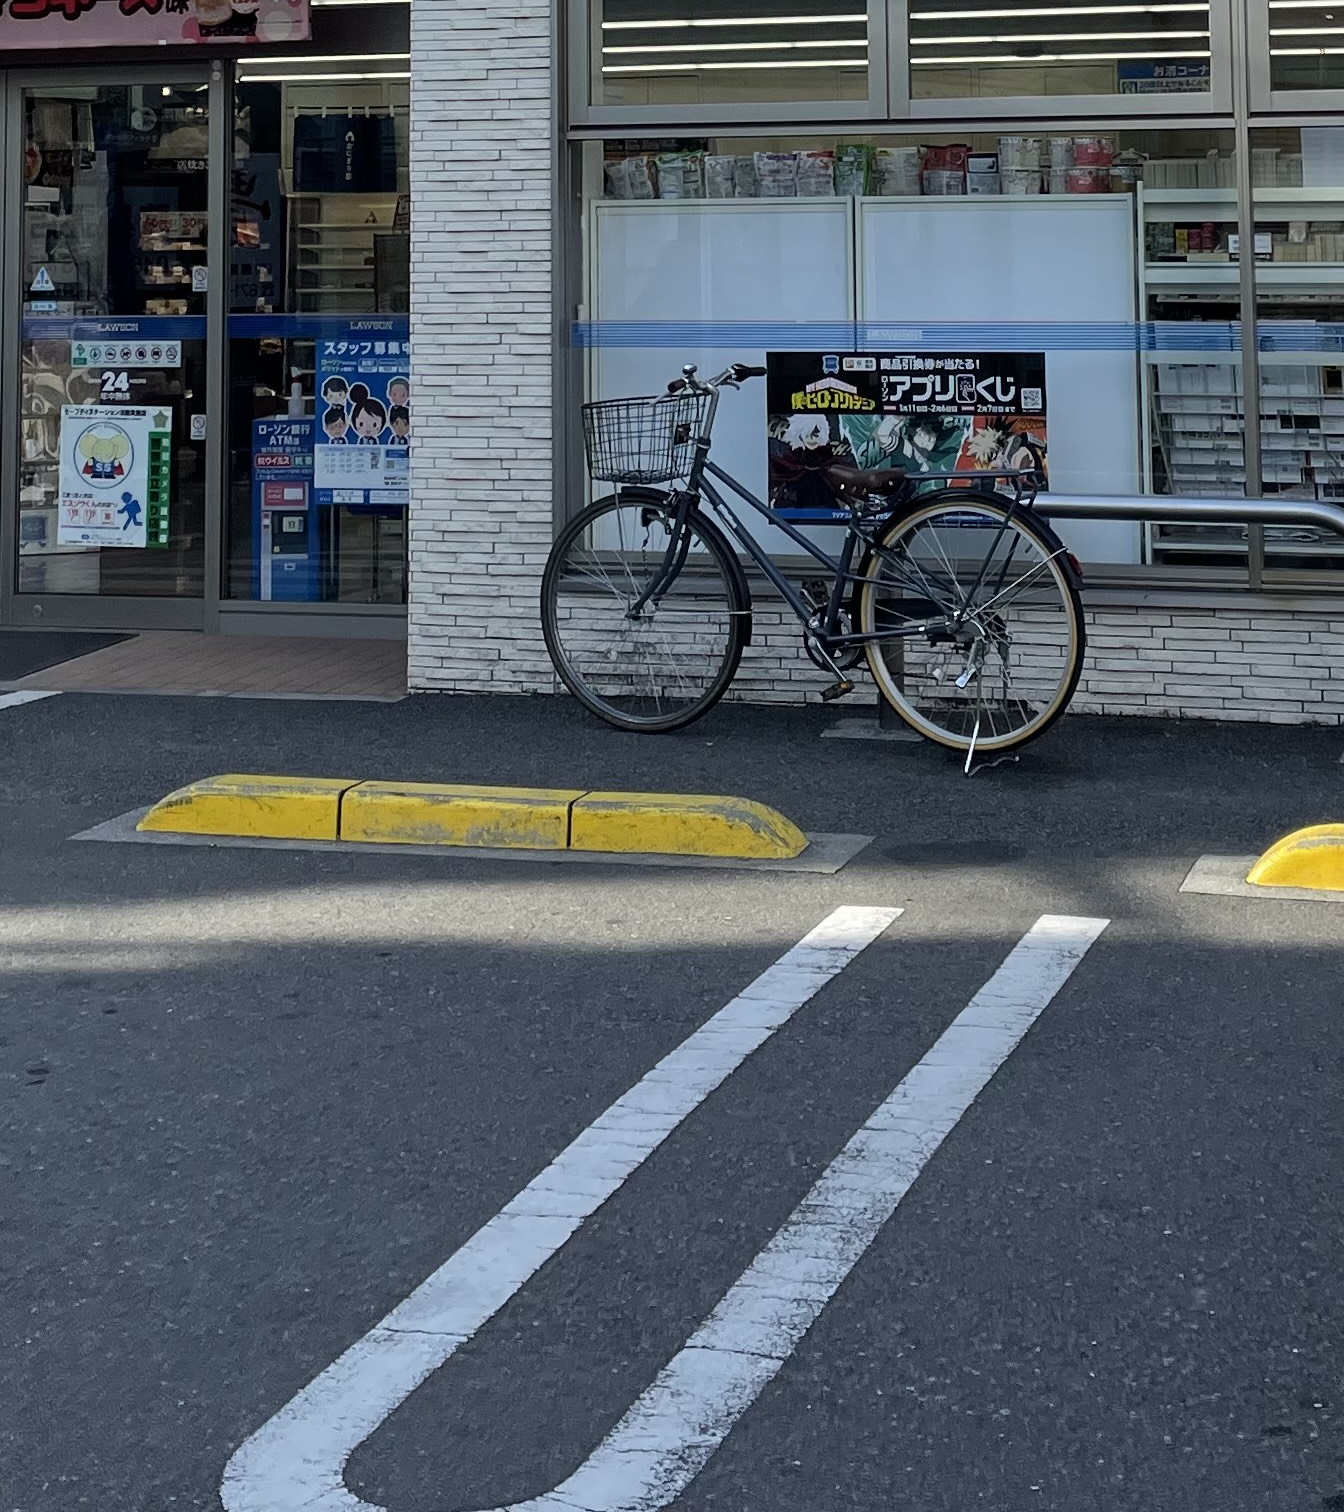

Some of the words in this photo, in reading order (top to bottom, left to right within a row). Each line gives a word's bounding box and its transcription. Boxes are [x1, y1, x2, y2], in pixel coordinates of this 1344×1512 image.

[97, 323, 138, 332] LAWSON
[350, 321, 393, 330] LAWSON
[101, 370, 130, 391] 24
[95, 463, 112, 472] SS
